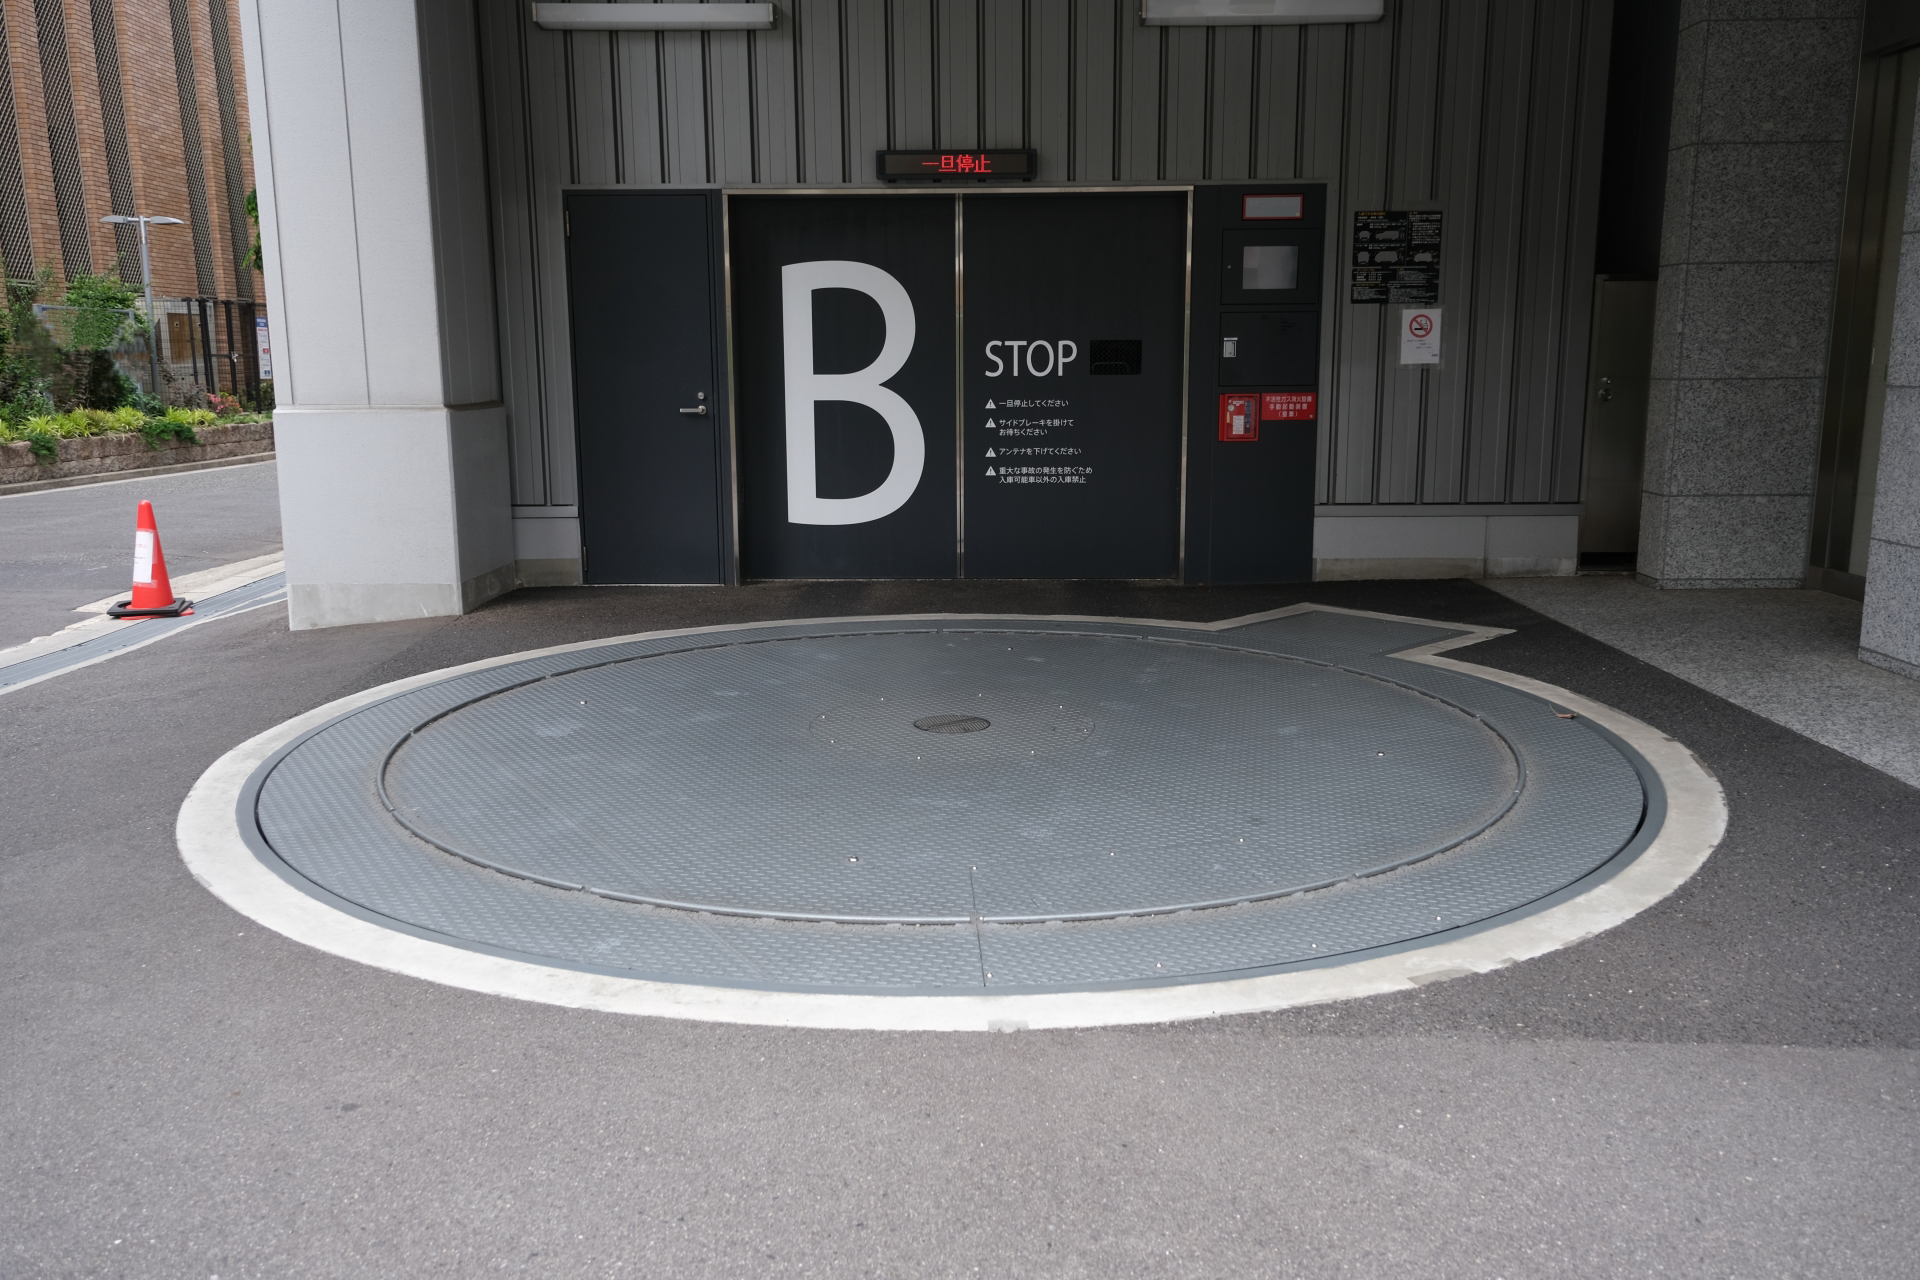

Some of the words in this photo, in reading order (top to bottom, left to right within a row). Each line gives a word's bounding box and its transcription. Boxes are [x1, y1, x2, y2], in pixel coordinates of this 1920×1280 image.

[921, 153, 992, 173] 一旦停止
[984, 339, 1078, 378] STOP
[781, 261, 926, 526] B
[998, 399, 1069, 408] 一旦停止してください
[998, 419, 1074, 427] サイドブレーキを掛けて
[998, 428, 1048, 437] お待ちください
[998, 447, 1082, 456] アンテナを下げてください
[998, 466, 1093, 475] 重大な事故の発生を防ぐため
[998, 475, 1087, 484] 入庫可能車以外の入庫禁止
